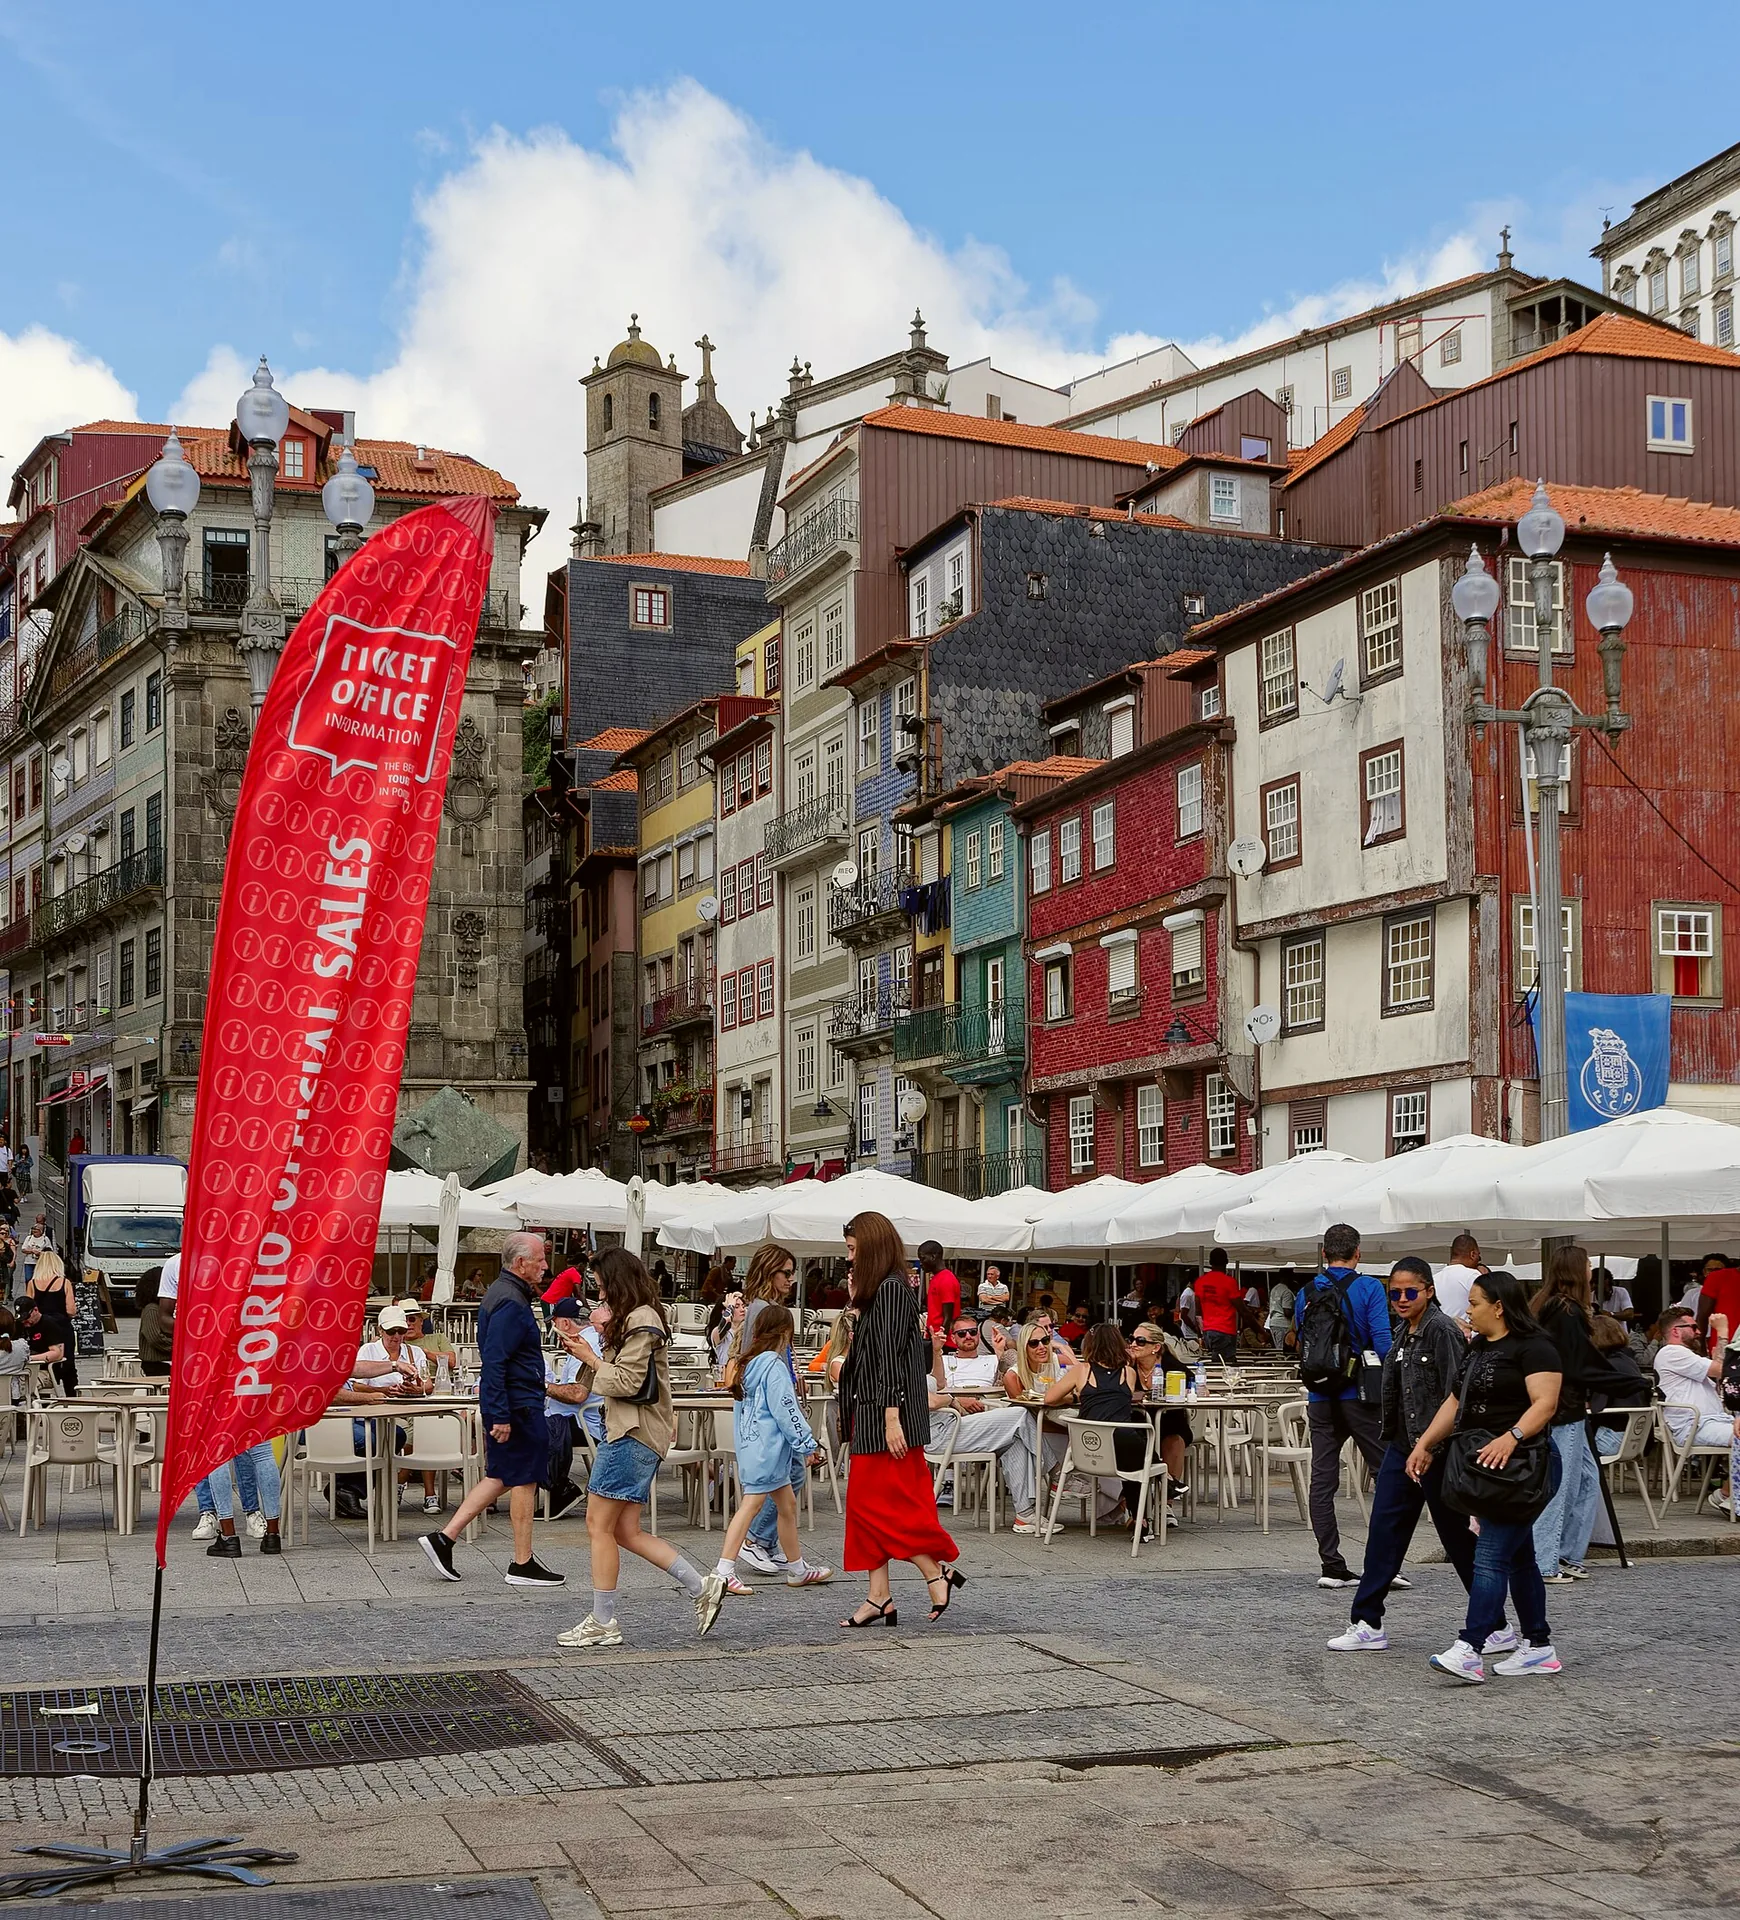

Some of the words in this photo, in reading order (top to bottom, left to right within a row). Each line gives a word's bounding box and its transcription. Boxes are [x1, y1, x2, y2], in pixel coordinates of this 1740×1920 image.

[341, 643, 436, 684] TICKET
[331, 679, 430, 723] OFFICE
[325, 712, 422, 747] INFORMATION
[384, 761, 400, 771] THE
[379, 787, 389, 796] IN
[313, 834, 372, 981] SALES
[1252, 1014, 1274, 1025] NOS
